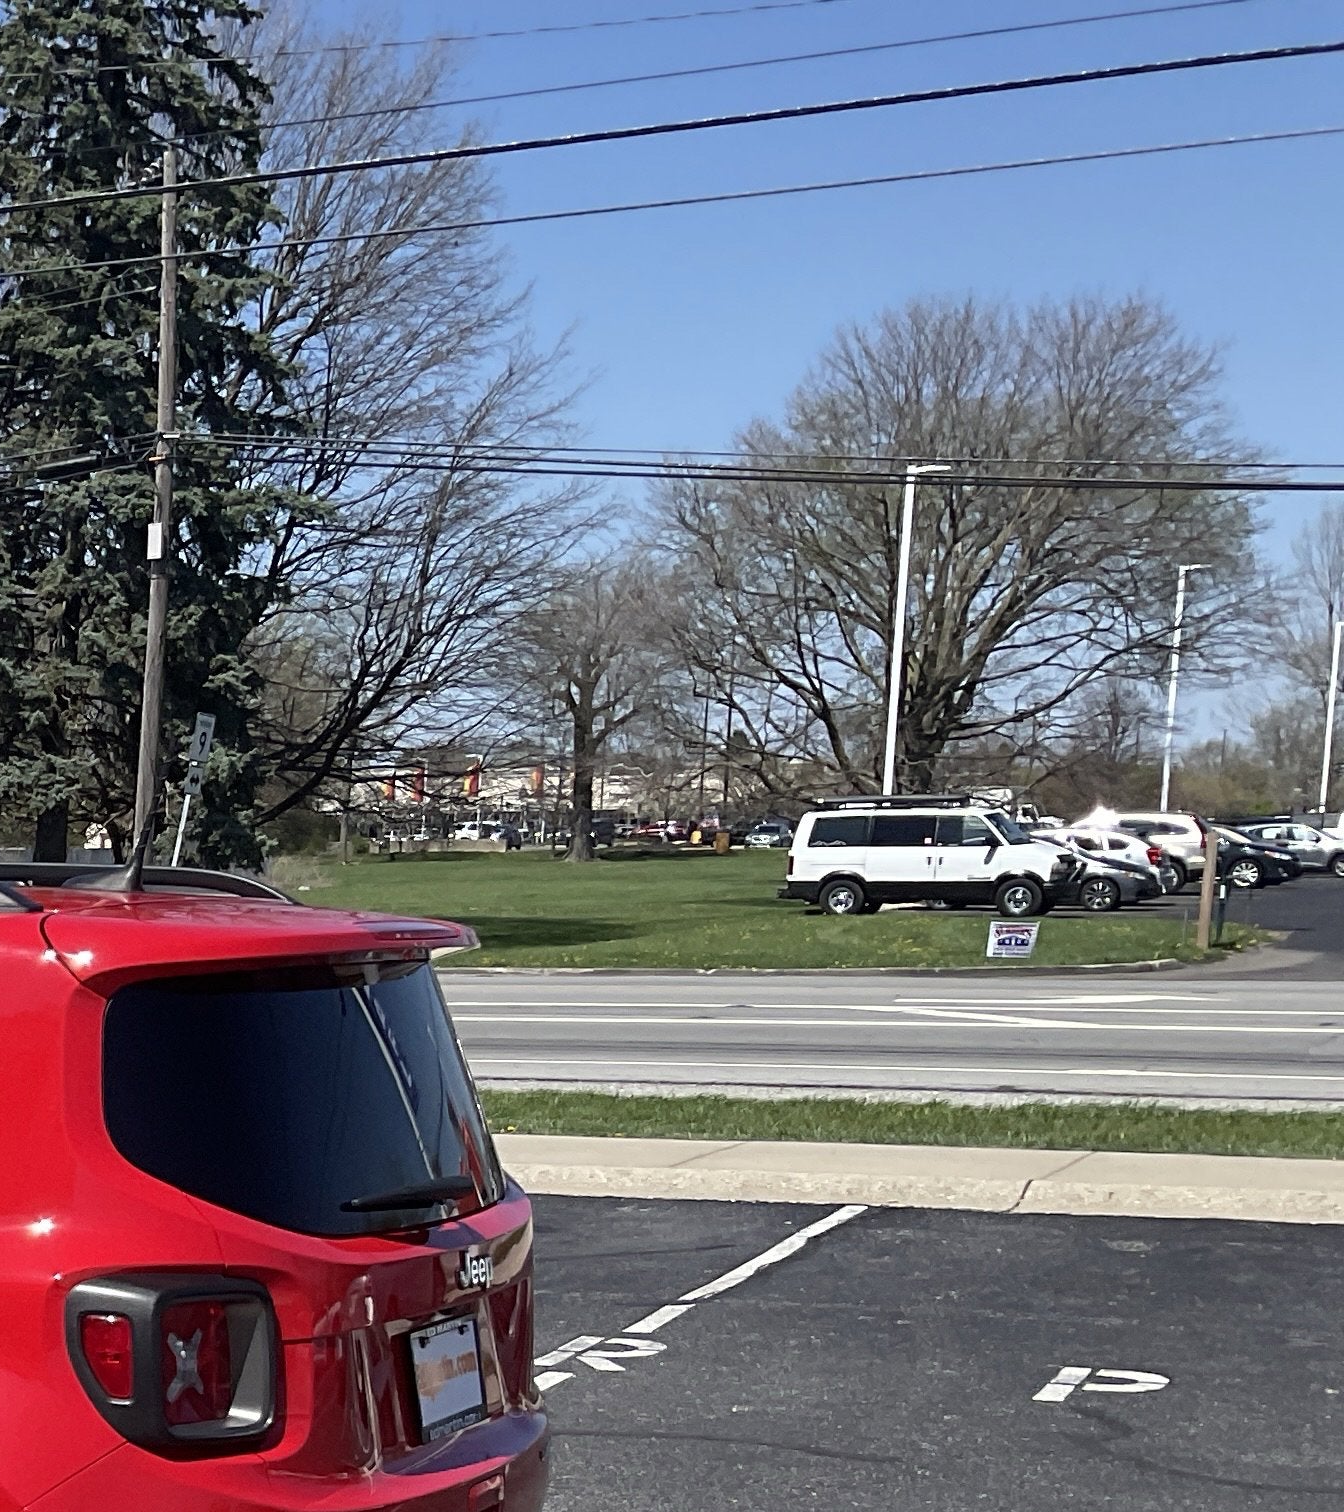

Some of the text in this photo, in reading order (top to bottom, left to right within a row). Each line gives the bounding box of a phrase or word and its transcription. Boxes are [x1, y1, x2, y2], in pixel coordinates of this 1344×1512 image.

[198, 731, 207, 756] 9
[457, 1251, 494, 1290] Jeep
[1032, 1366, 1172, 1403] P
